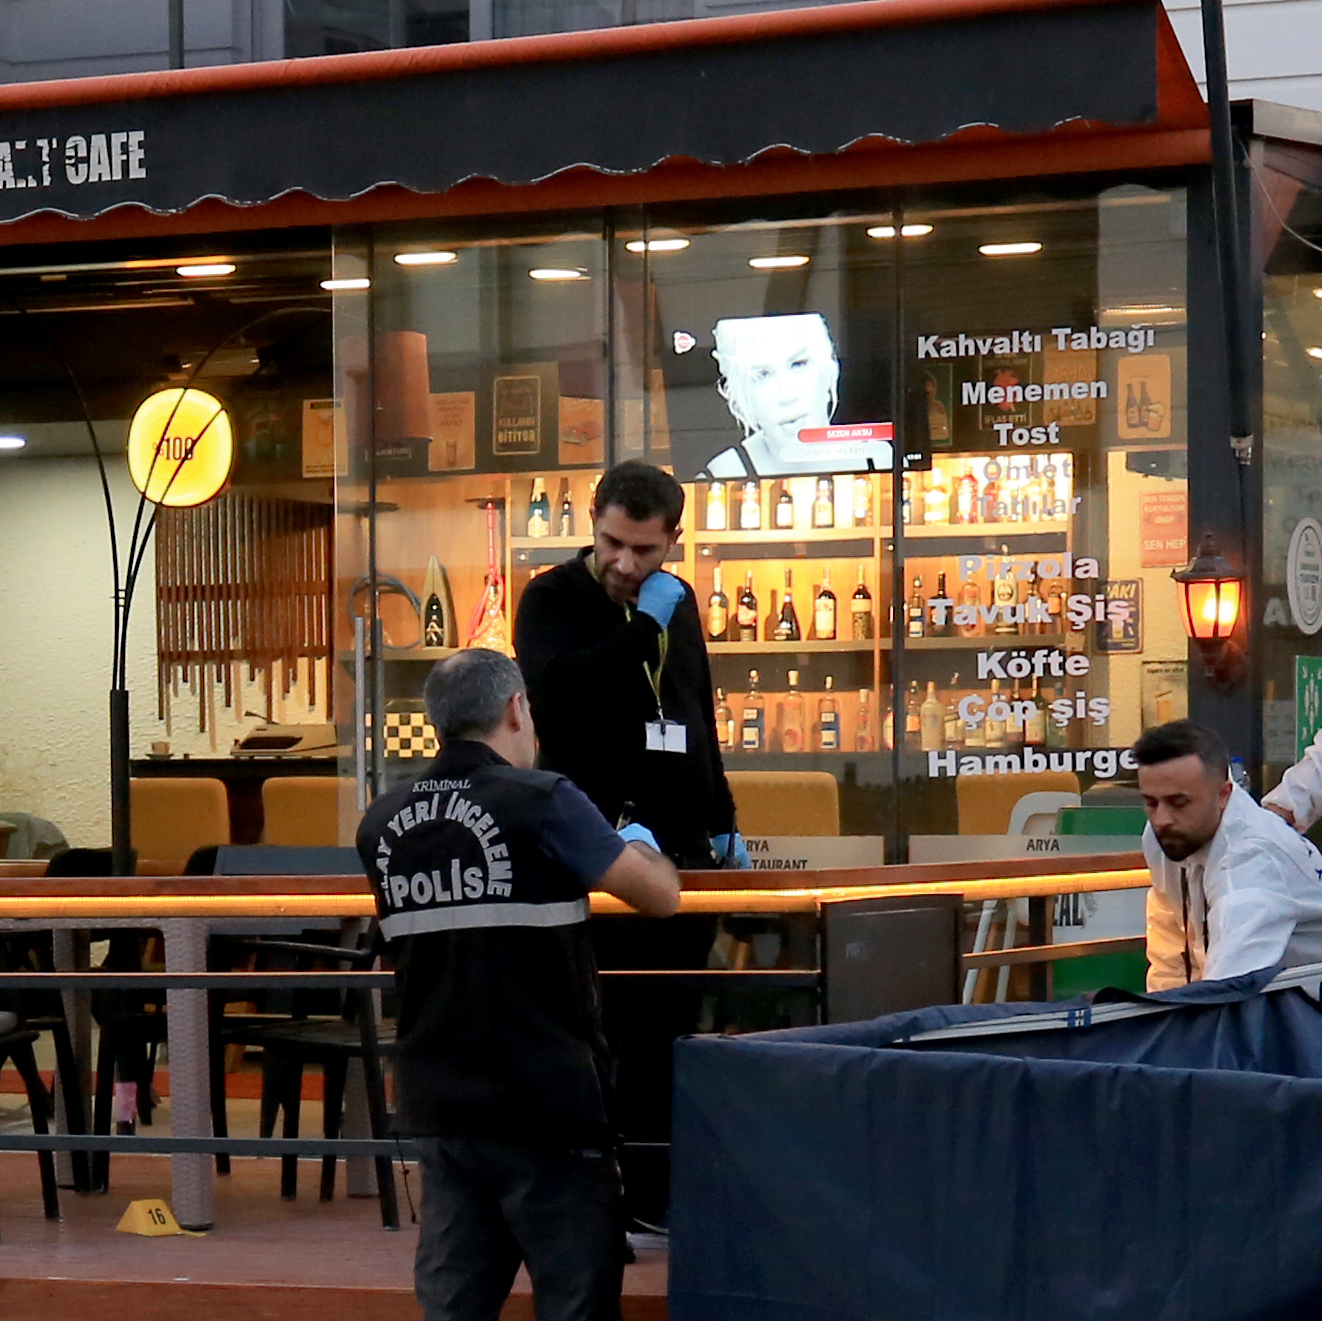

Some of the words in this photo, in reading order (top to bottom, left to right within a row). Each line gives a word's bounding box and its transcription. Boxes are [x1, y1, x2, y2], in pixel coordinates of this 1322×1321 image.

[65, 131, 147, 185] CAFE
[917, 330, 1042, 359] Kahvaltı
[1051, 324, 1155, 353] Tabağı
[961, 380, 1107, 405] Menemen
[993, 421, 1060, 446] Tost
[983, 456, 1072, 481] Omlet
[959, 552, 1099, 580] Pirzola
[927, 595, 1052, 626] Tavuk
[977, 650, 1091, 680] Köfte
[958, 695, 1038, 730] Çöp
[1051, 691, 1111, 727] şiş
[929, 747, 1141, 778] Hamburge
[746, 840, 770, 852] RYA
[1026, 838, 1061, 852] ARYA
[148, 1207, 167, 1226] 16
